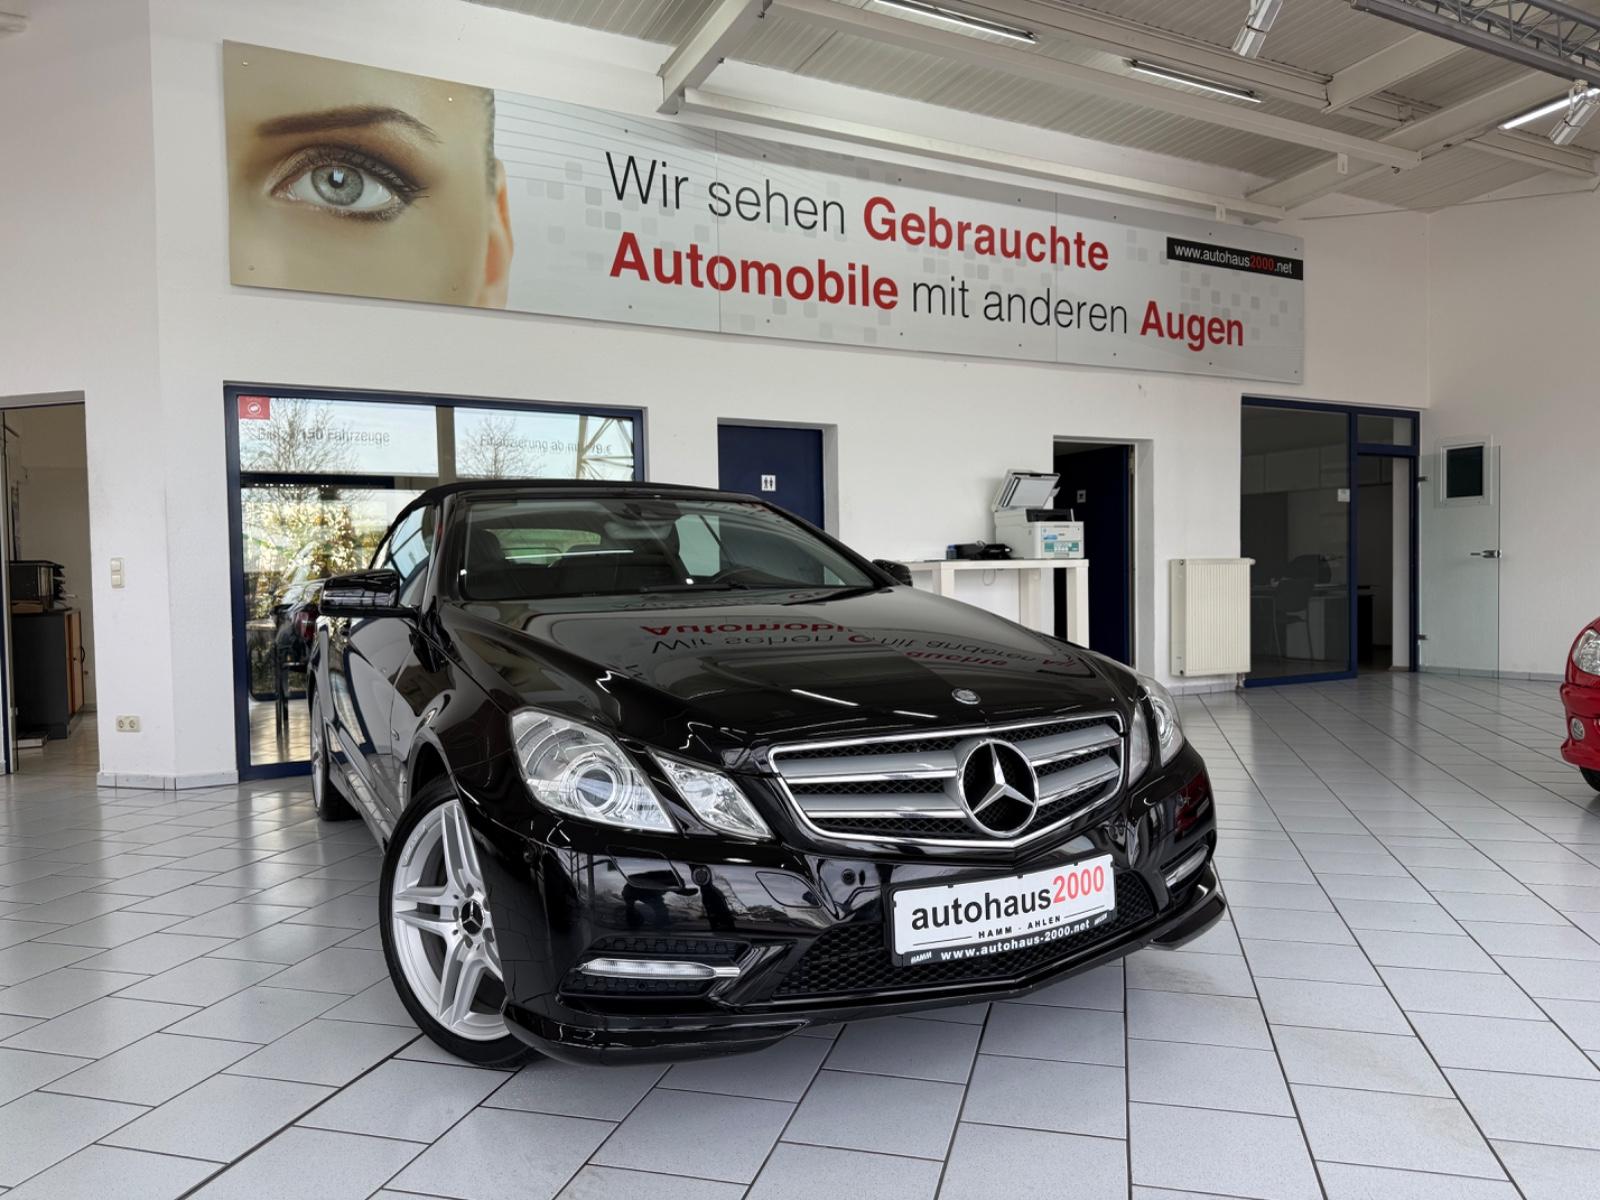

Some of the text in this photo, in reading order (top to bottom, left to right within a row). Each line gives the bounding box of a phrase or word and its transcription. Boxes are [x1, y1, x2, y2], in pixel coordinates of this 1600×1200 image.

[605, 151, 1109, 272] Wir sehen Gebrauchte
[1173, 244, 1293, 274] www.autohaus2000.net
[609, 231, 1244, 351] Automobile mit anderen Augen
[327, 428, 391, 445] Fahrzeuge
[551, 439, 565, 450] ab
[911, 865, 1105, 931] autohaus2000
[940, 921, 1090, 961] www.autohaus-2000.net
[977, 926, 1013, 939] HAMM
[1027, 915, 1061, 930] AHLEN
